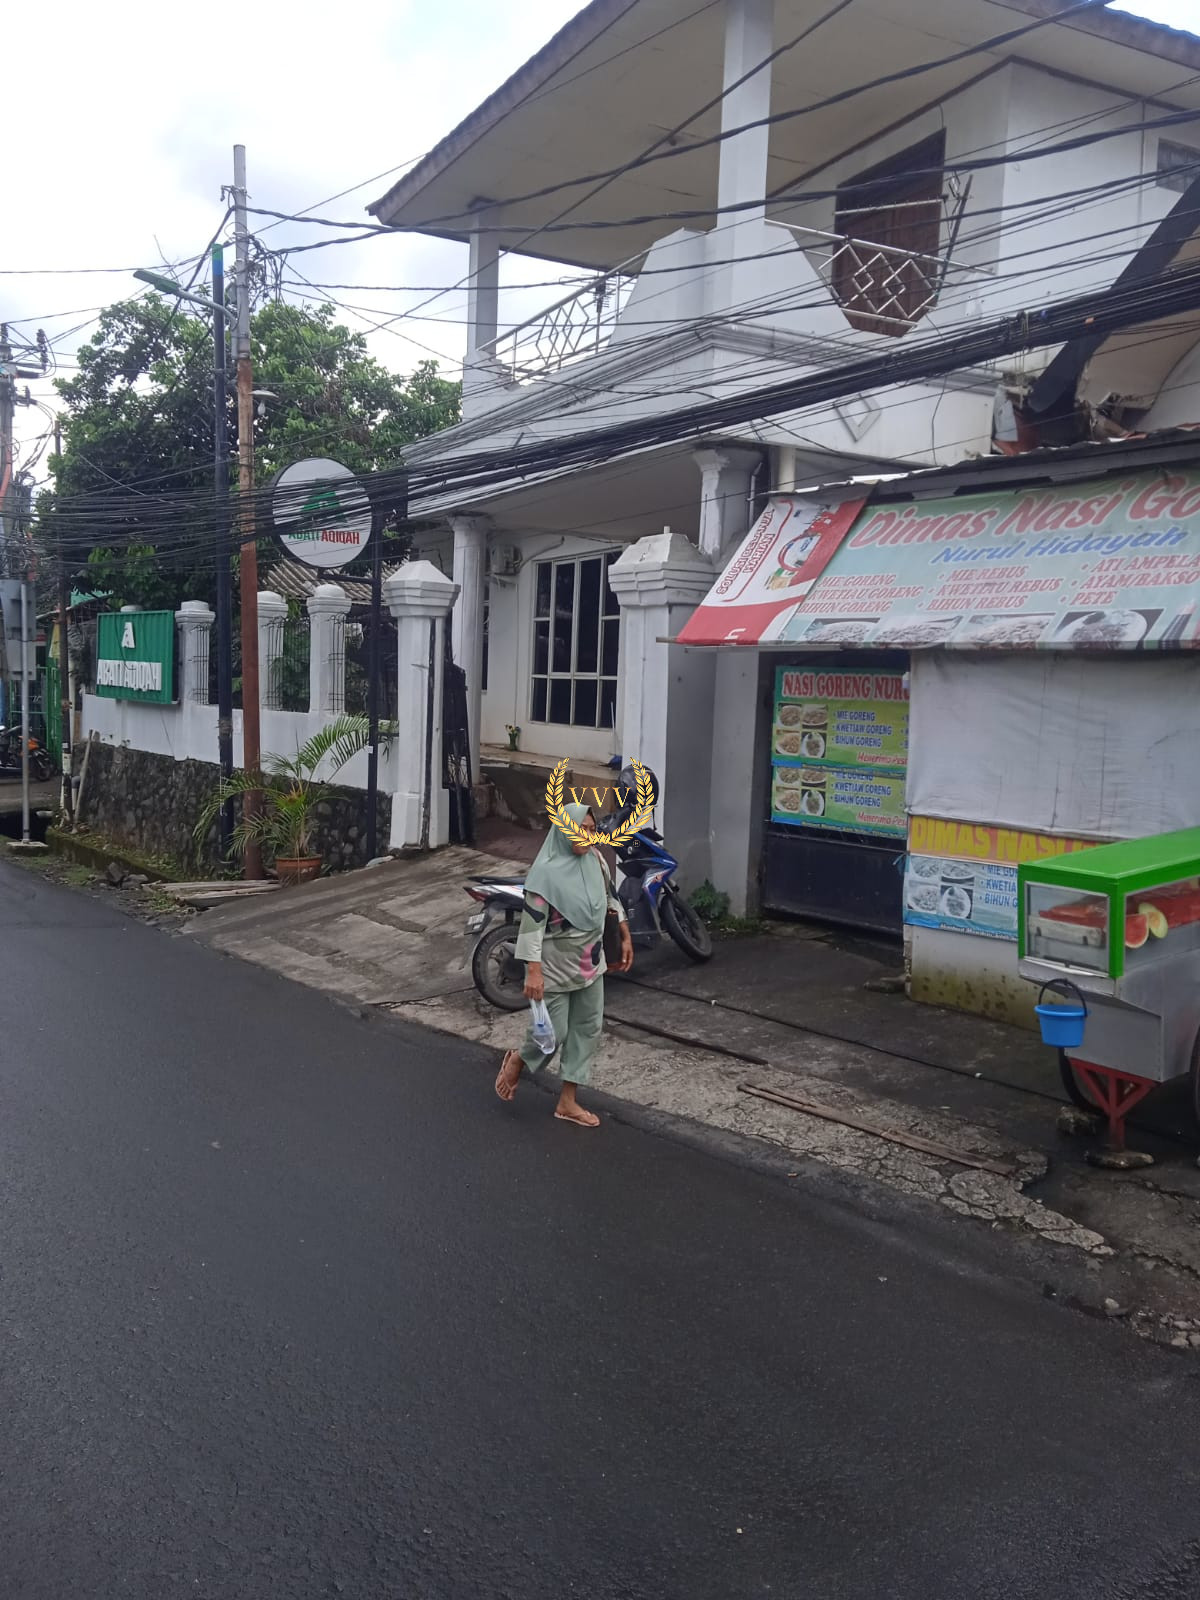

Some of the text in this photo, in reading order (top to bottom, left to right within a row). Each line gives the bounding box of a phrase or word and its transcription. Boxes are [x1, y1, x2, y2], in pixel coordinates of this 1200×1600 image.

[849, 476, 1200, 549] Dimas Nasi Go
[321, 529, 360, 545] AQIQAH
[930, 526, 1189, 563] Nurul Hidayah
[743, 533, 775, 573] HARIAN
[1091, 554, 1200, 573] ATI AMPELA
[716, 554, 747, 595] SOLUSI
[818, 574, 896, 587] MIE GORENG
[948, 565, 1029, 581] MIE REBUS
[1009, 578, 1064, 593] REBUS
[808, 586, 924, 601] KWETIAU GORENG
[1069, 591, 1117, 606] PETE
[799, 600, 892, 614] BIHUN GORENG
[926, 595, 1028, 611] BIHUN REBUS
[783, 673, 814, 697] NASI
[816, 674, 871, 699] GORENG
[836, 711, 875, 722] MIE GORENG
[835, 723, 864, 734] KWETIAW
[865, 725, 892, 736] GORENG
[835, 736, 882, 748] BIHUN GORENG
[834, 783, 892, 796] KWETIAW GORENG
[834, 795, 881, 808] BIHUN GORENG
[911, 815, 991, 859] DIMAS
[996, 829, 1065, 862] NASI
[984, 892, 1010, 907] BIHUN
